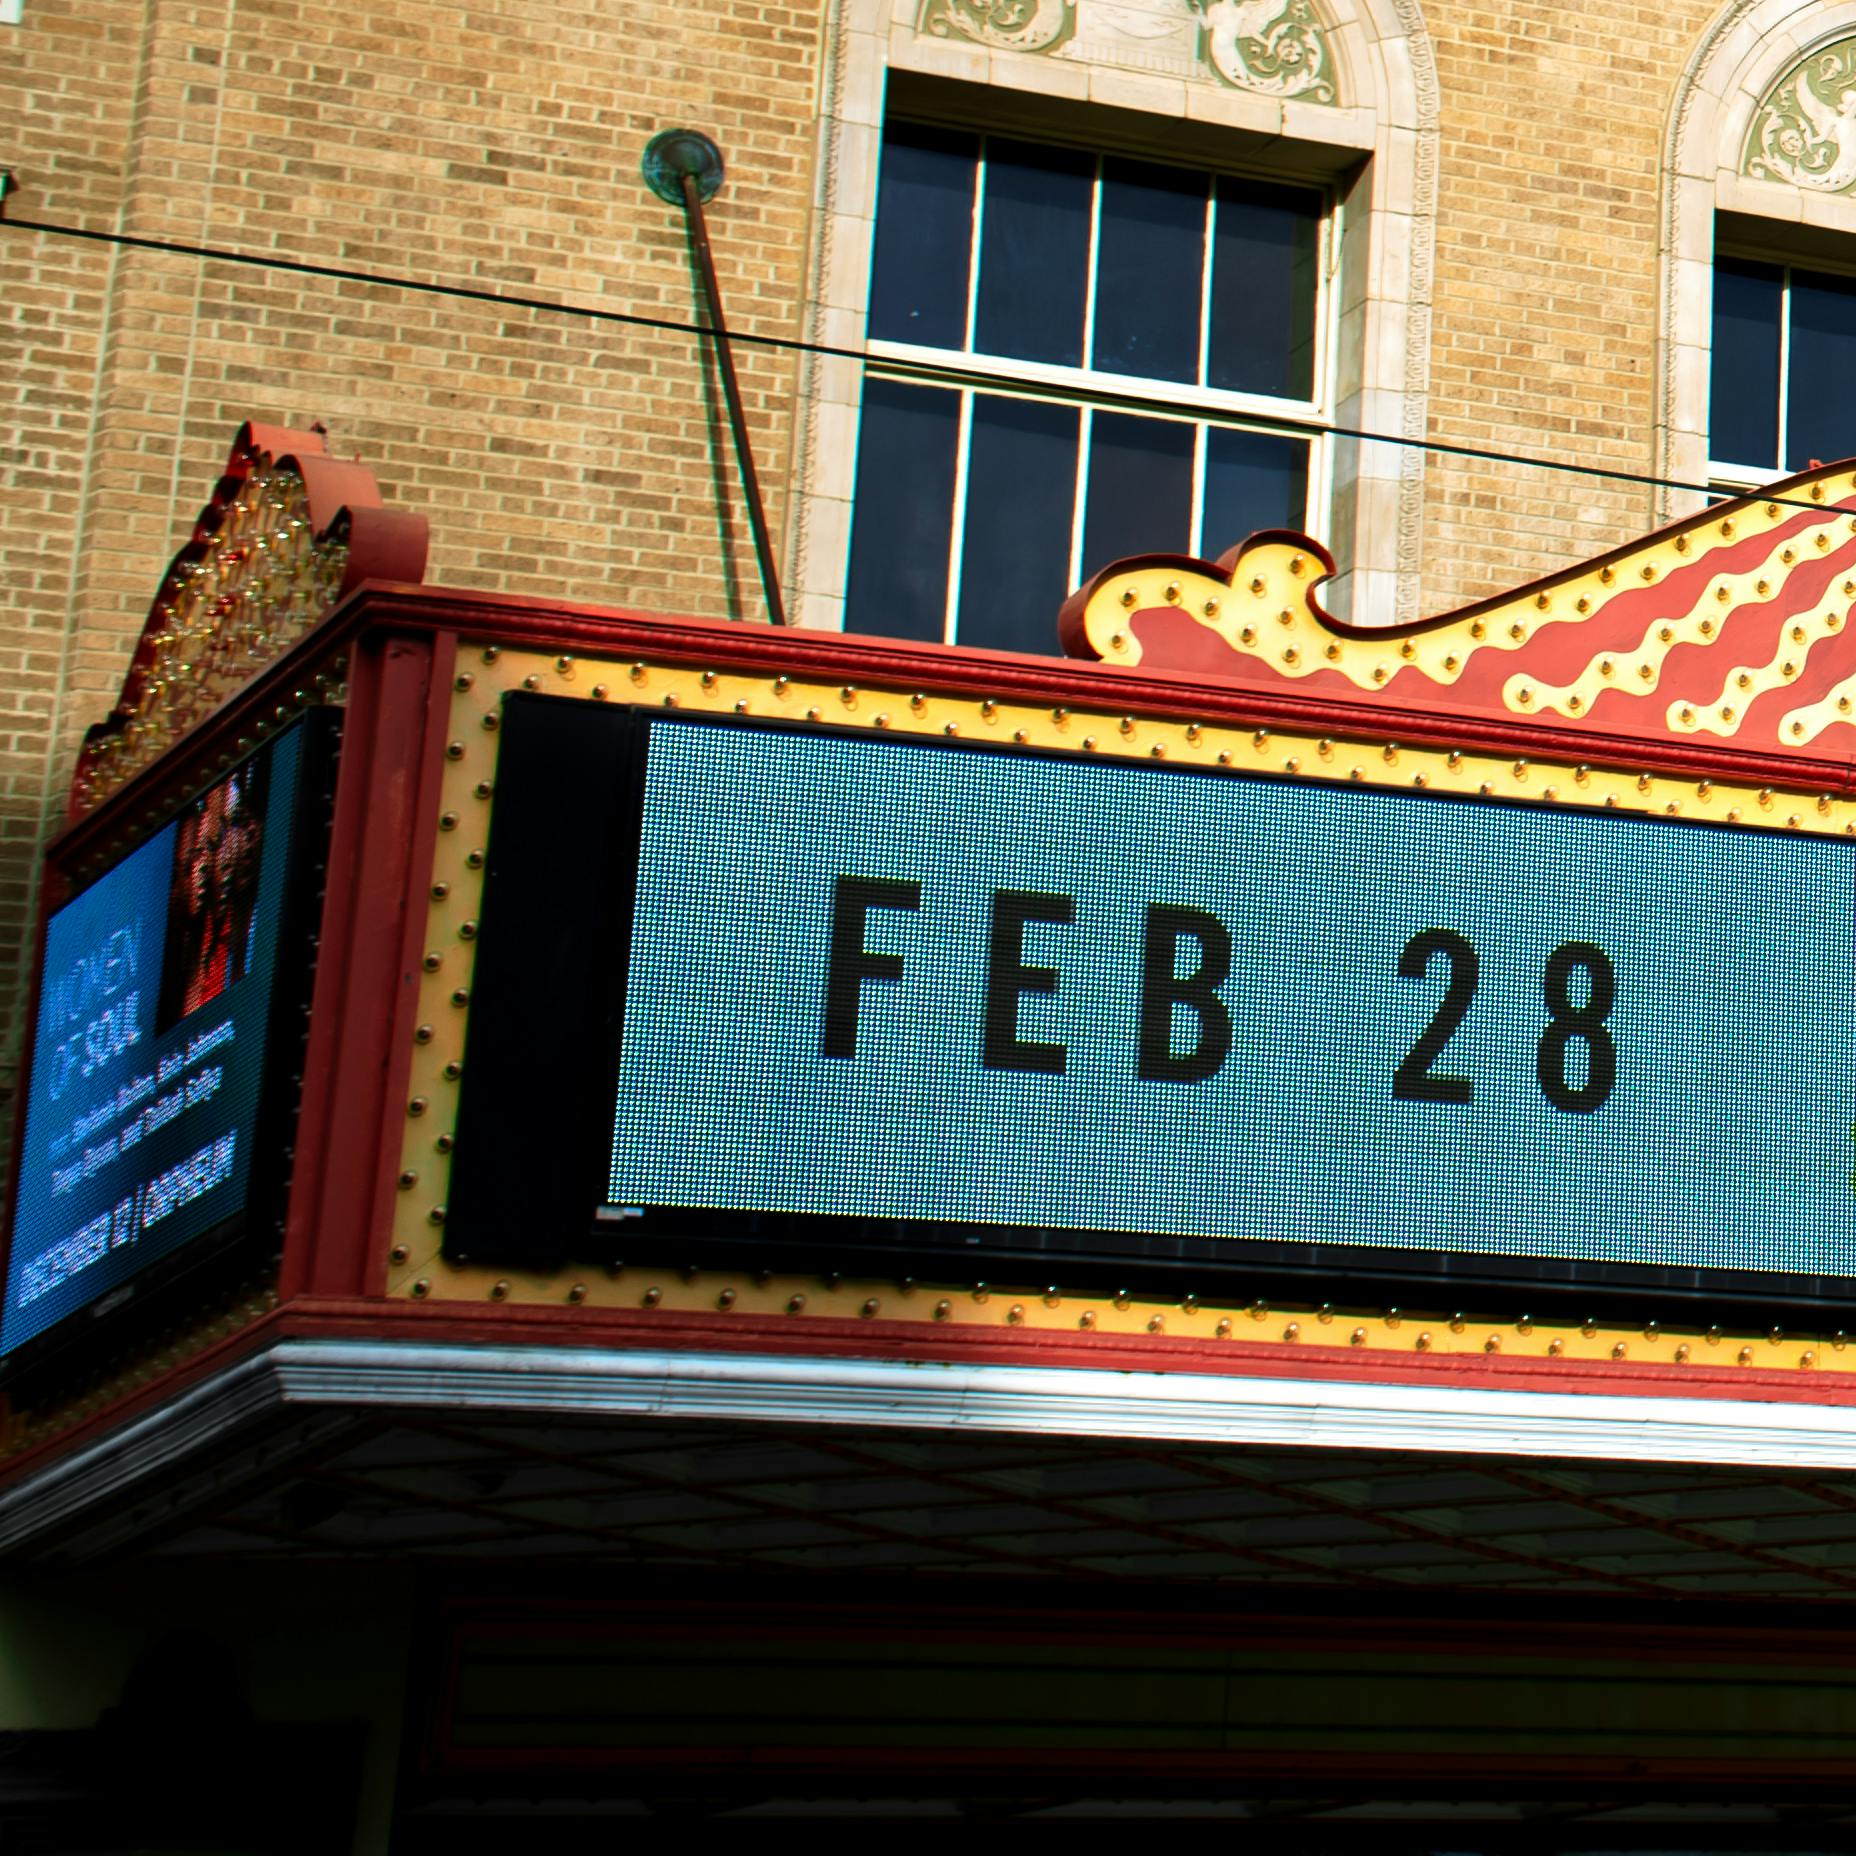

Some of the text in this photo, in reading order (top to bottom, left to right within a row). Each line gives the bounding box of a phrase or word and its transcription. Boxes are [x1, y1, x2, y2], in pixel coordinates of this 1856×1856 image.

[46, 912, 142, 1040] WOMEN
[821, 873, 1619, 1114] FEB 28
[48, 1028, 84, 1104] OF
[79, 988, 142, 1080] SOUL
[17, 1208, 112, 1311] DECEMBER
